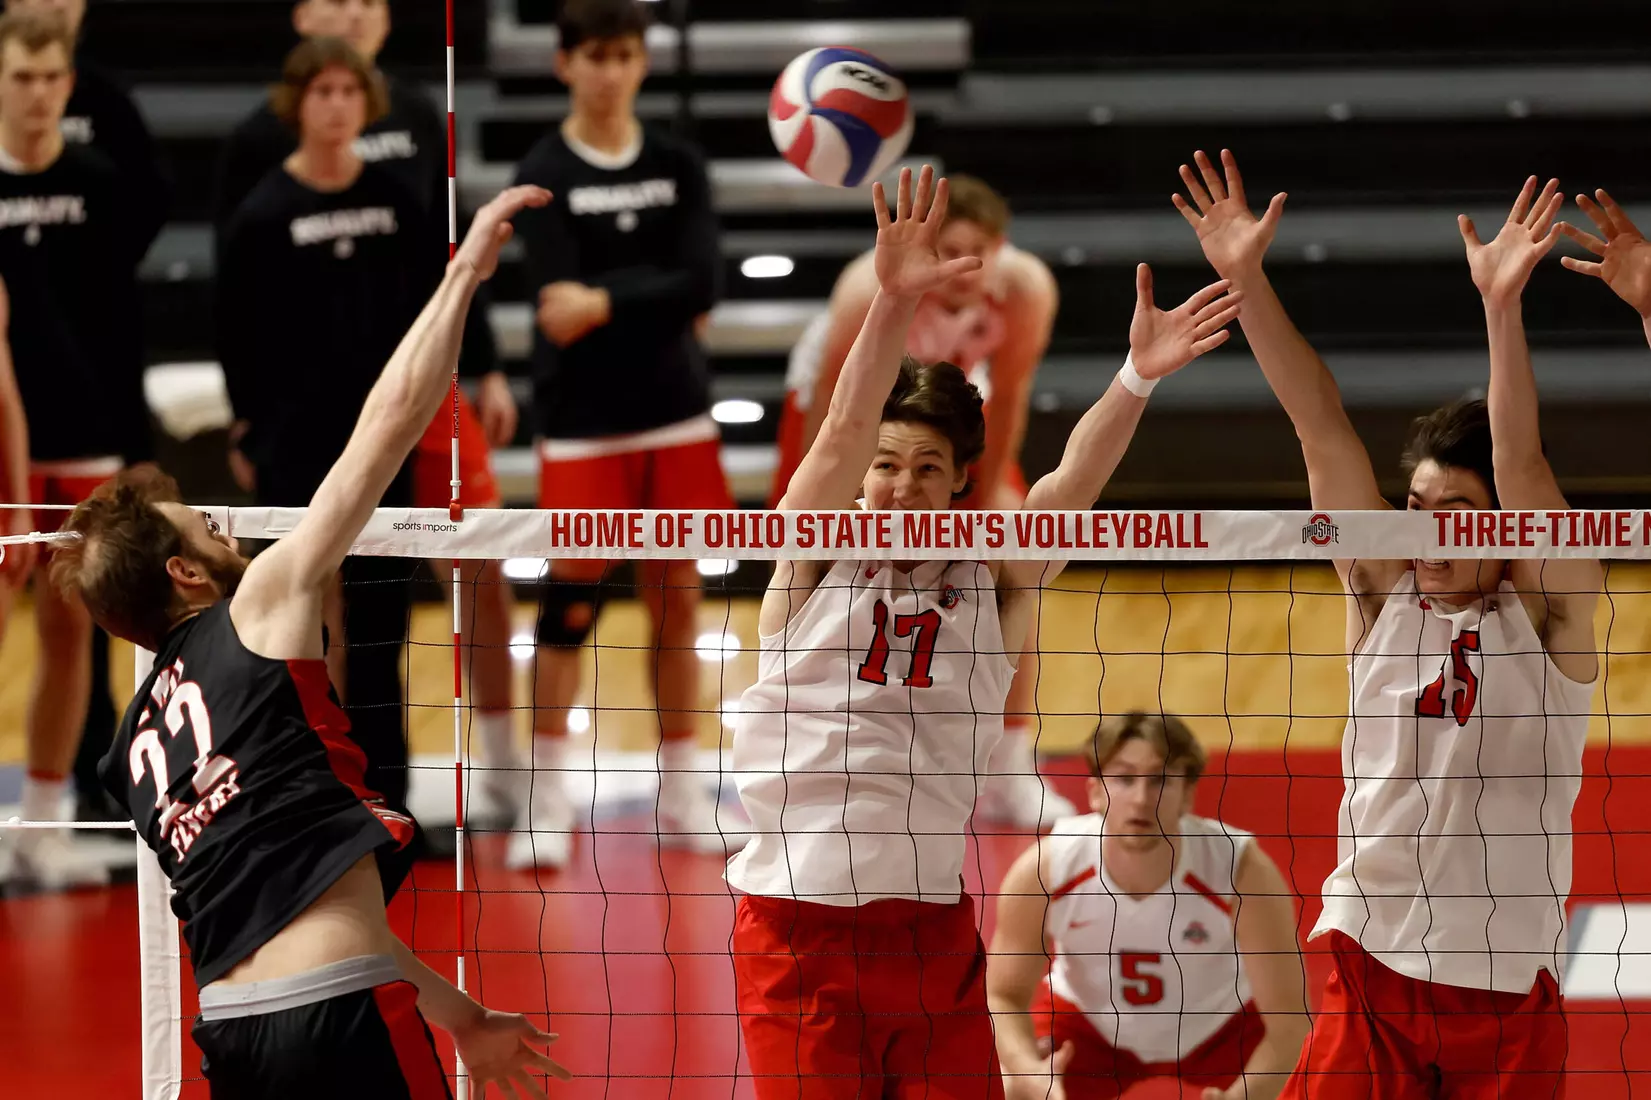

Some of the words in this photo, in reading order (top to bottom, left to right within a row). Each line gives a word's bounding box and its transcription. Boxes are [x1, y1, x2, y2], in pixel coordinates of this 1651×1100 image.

[393, 522, 421, 531] sports
[423, 524, 457, 532] imports
[551, 513, 643, 548] HOME
[655, 513, 693, 548] OF
[704, 513, 785, 548] OHIO
[796, 513, 892, 548] STATE
[903, 513, 1005, 548] MEN’S
[1014, 513, 1209, 548] VOLLEYBALL
[1302, 525, 1317, 544] OHIO
[1317, 522, 1339, 544] STATE
[1433, 512, 1631, 547] THREE-TIME
[857, 599, 941, 688] 17
[1415, 629, 1480, 727] 15
[130, 680, 237, 839] 22
[1120, 950, 1164, 1007] 5
